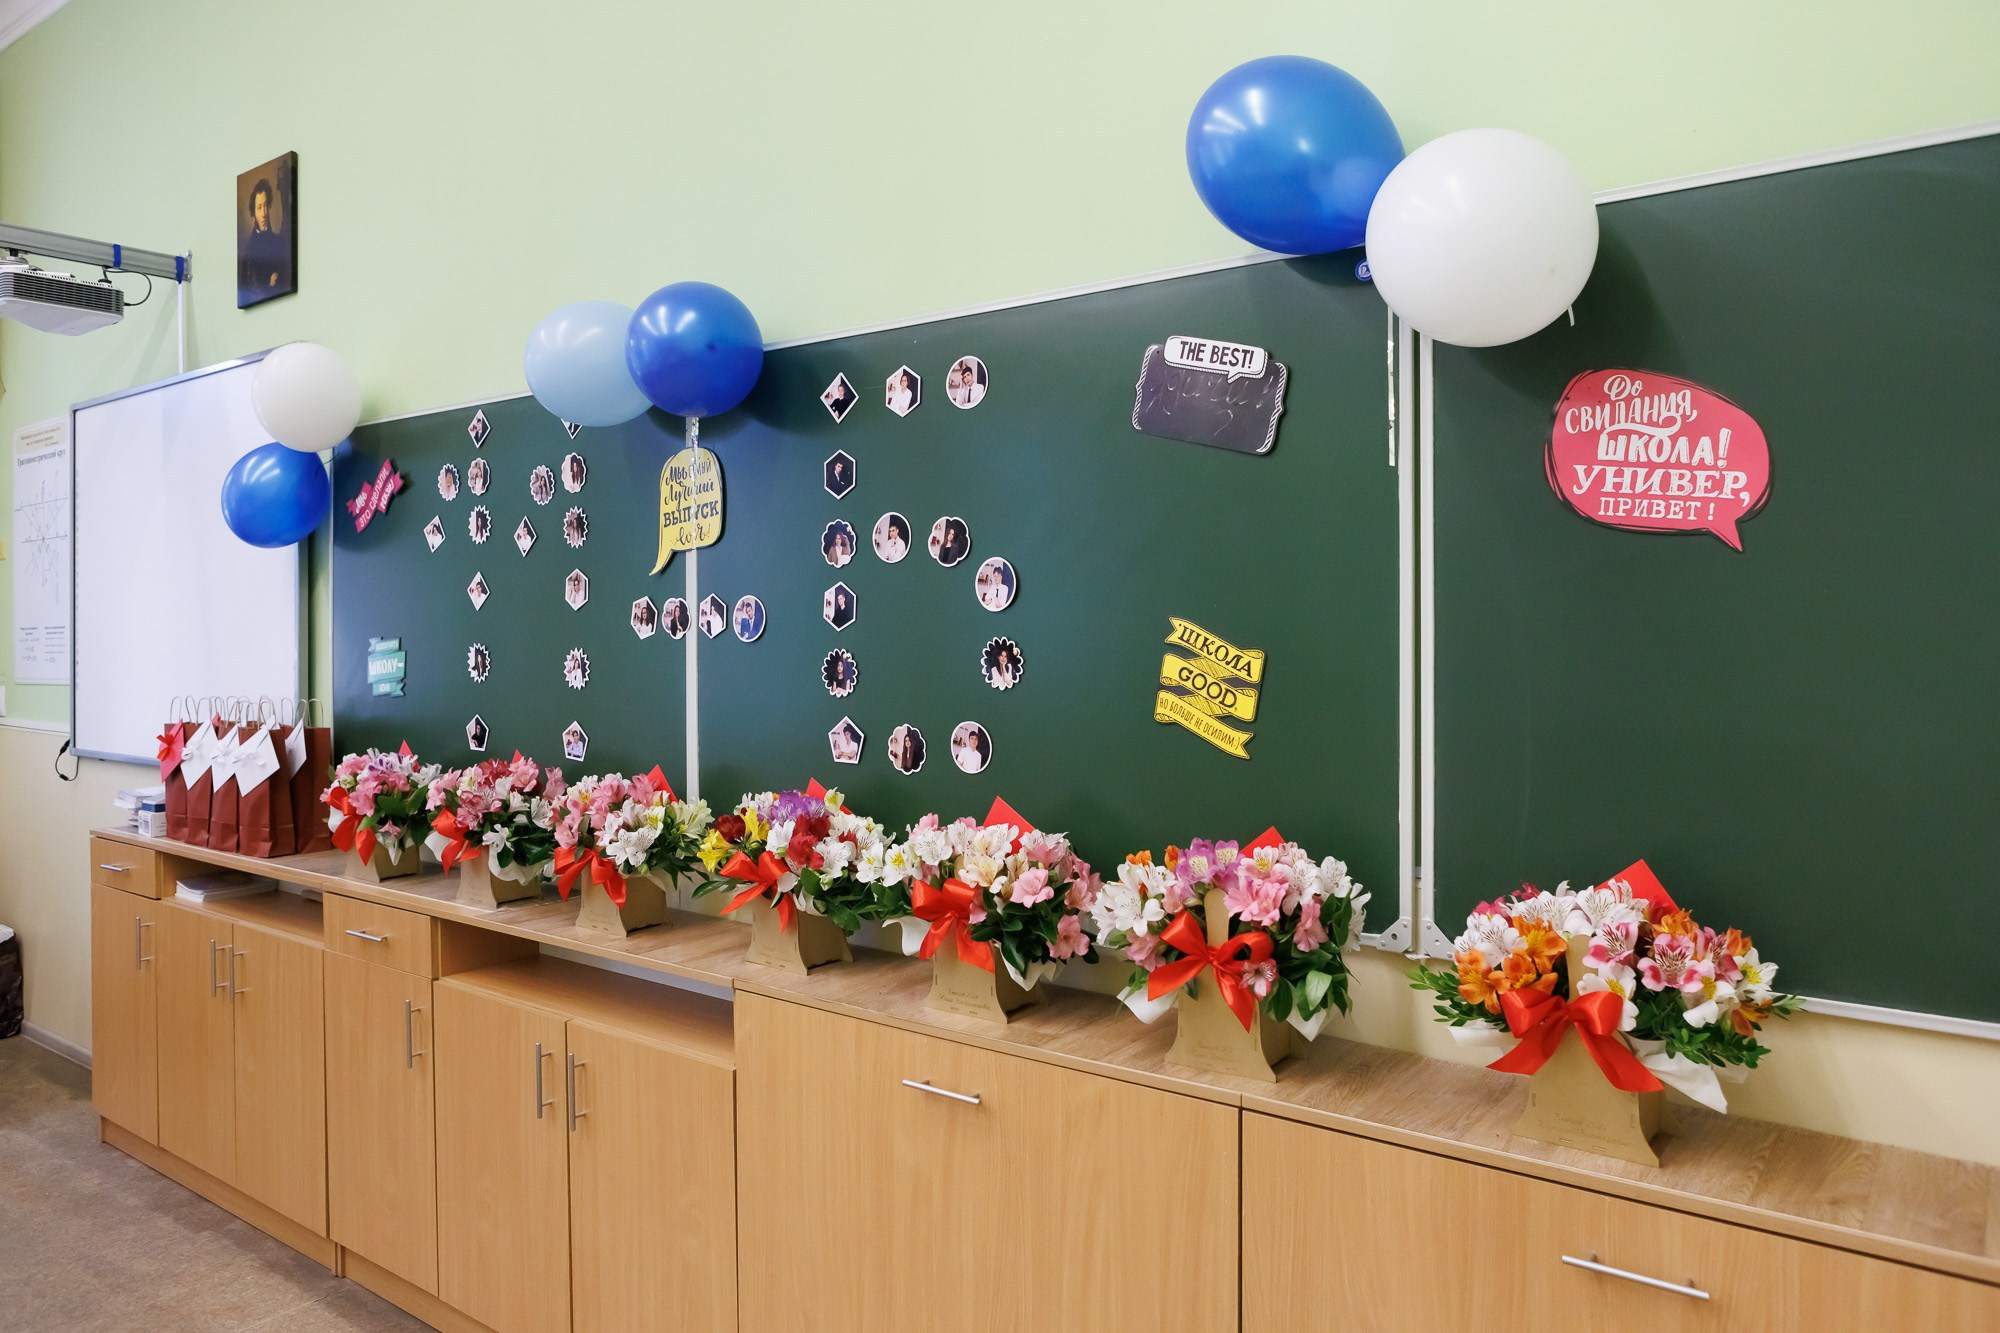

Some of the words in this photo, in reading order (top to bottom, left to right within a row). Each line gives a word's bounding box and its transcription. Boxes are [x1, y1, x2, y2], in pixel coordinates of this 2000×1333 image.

[1179, 341, 1206, 363] THE
[1209, 345, 1255, 369] BEST!
[1603, 374, 1643, 401] До
[1565, 389, 1698, 434] СВИДАНИЯ,
[1597, 427, 1732, 469] ШКОЛА!
[665, 465, 688, 486] Мы
[1572, 464, 1752, 508] УНИВЕР,
[1178, 625, 1253, 679] ШКОЛА
[1178, 666, 1239, 712] GOOD,
[1158, 697, 1169, 710] НО
[1170, 700, 1196, 725] БОЛЬШЕ
[1195, 717, 1204, 730] НЕ
